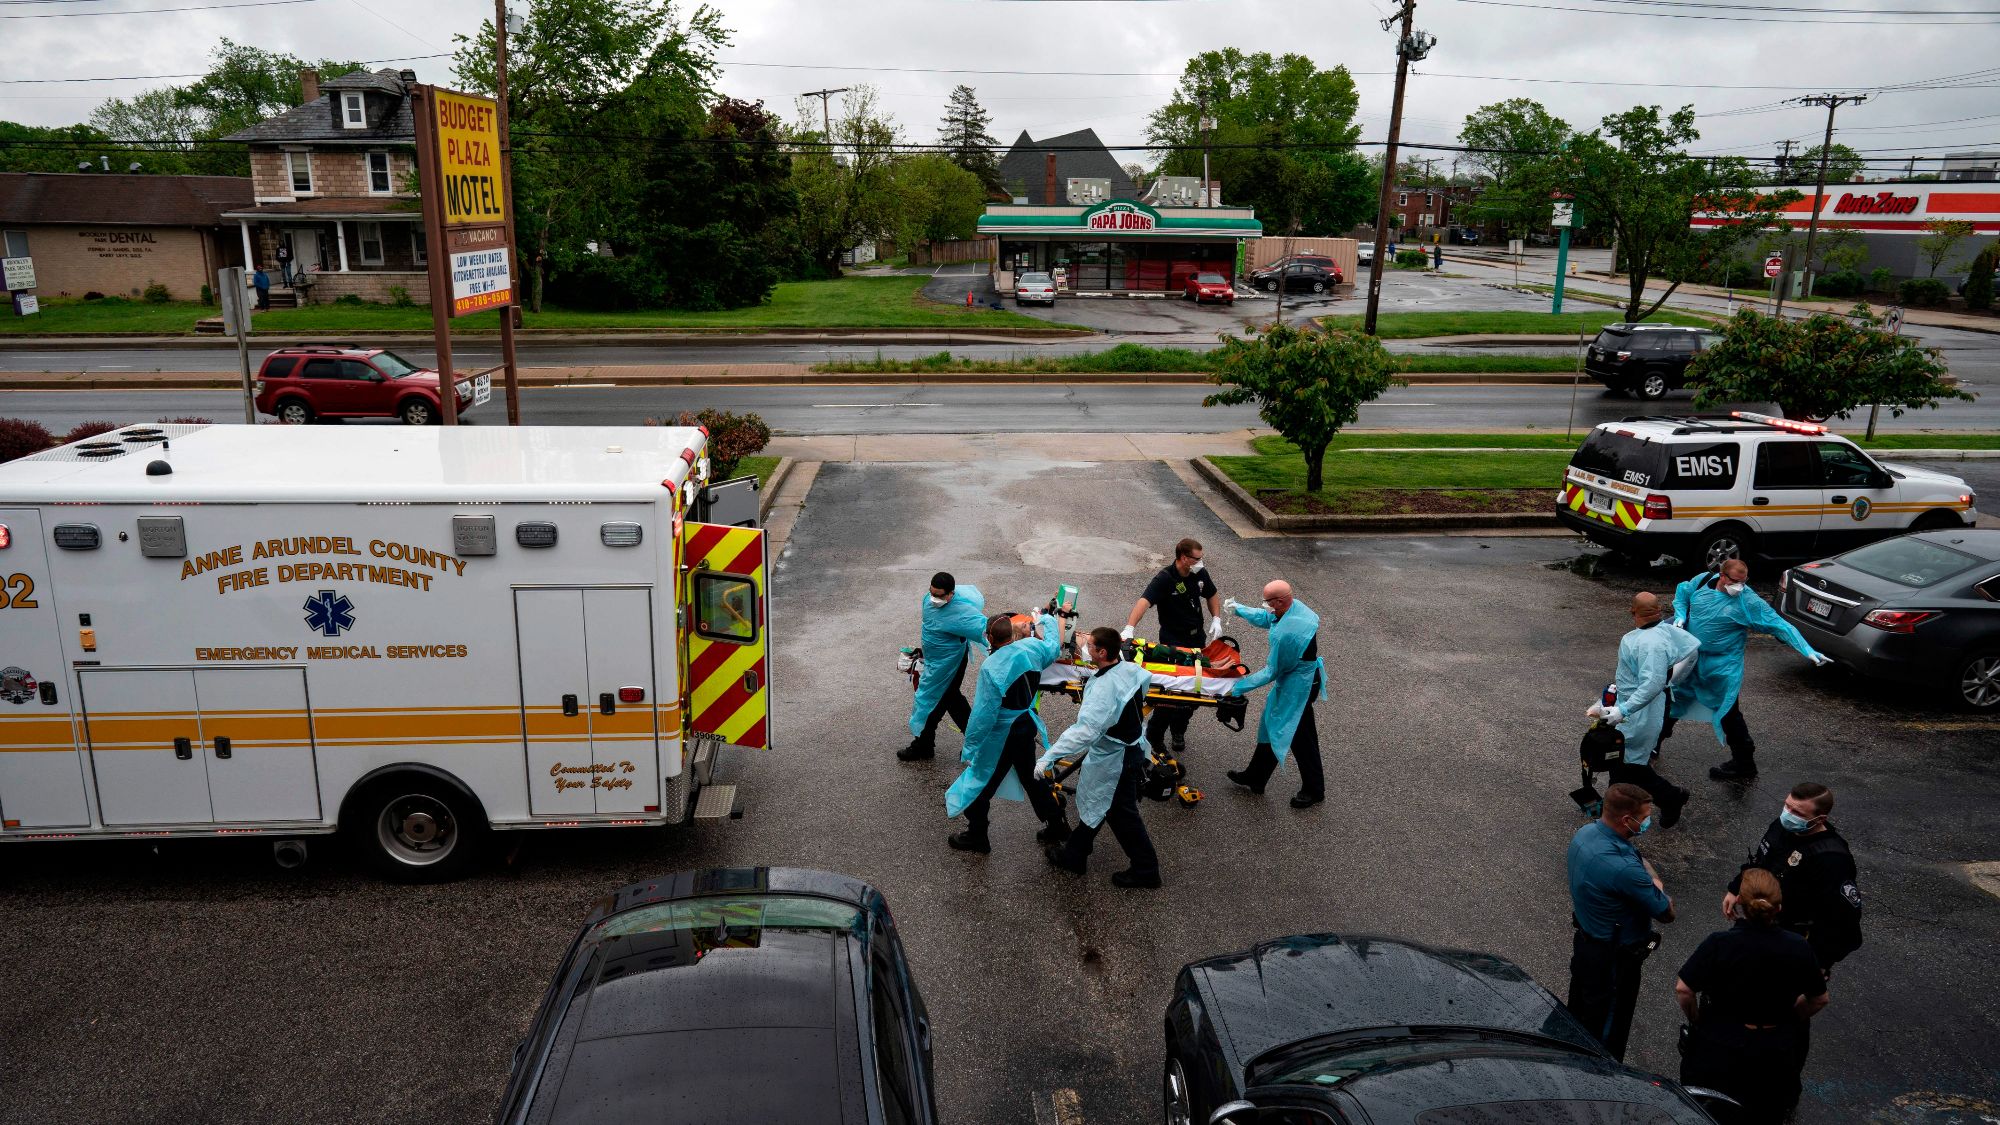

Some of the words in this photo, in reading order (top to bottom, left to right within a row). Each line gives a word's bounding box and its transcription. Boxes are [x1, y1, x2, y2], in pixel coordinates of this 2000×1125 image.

[439, 100, 492, 132] BUDGET
[448, 138, 490, 166] PLAZA
[446, 175, 500, 215] MOTEL
[1833, 192, 1919, 214] AutoZone
[1092, 214, 1117, 228] PAPA
[109, 232, 157, 243] DENTAL
[469, 229, 497, 242] VACANCY
[457, 255, 467, 267] LOW
[469, 253, 486, 266] WEEKLY
[488, 252, 502, 263] RATES
[453, 268, 484, 282] KITCHENETTES
[486, 265, 507, 277] AVAILABLE
[469, 283, 481, 294] FREE
[1676, 455, 1733, 477] EMS1
[1623, 470, 1651, 486] EMS1
[181, 545, 243, 580] ANNE
[252, 536, 361, 560] ARUNDEL
[369, 540, 467, 577] COUNTY
[218, 568, 269, 594] FIRE
[278, 563, 433, 592] DEPARTMENT
[195, 646, 298, 660] EMERGENCY
[306, 646, 381, 660] MEDICAL
[386, 645, 468, 658] SERVICES
[694, 731, 727, 743] 390622
[550, 762, 616, 776] Committed
[619, 761, 635, 774] To
[555, 777, 586, 793] Your
[590, 776, 633, 791] Safety
